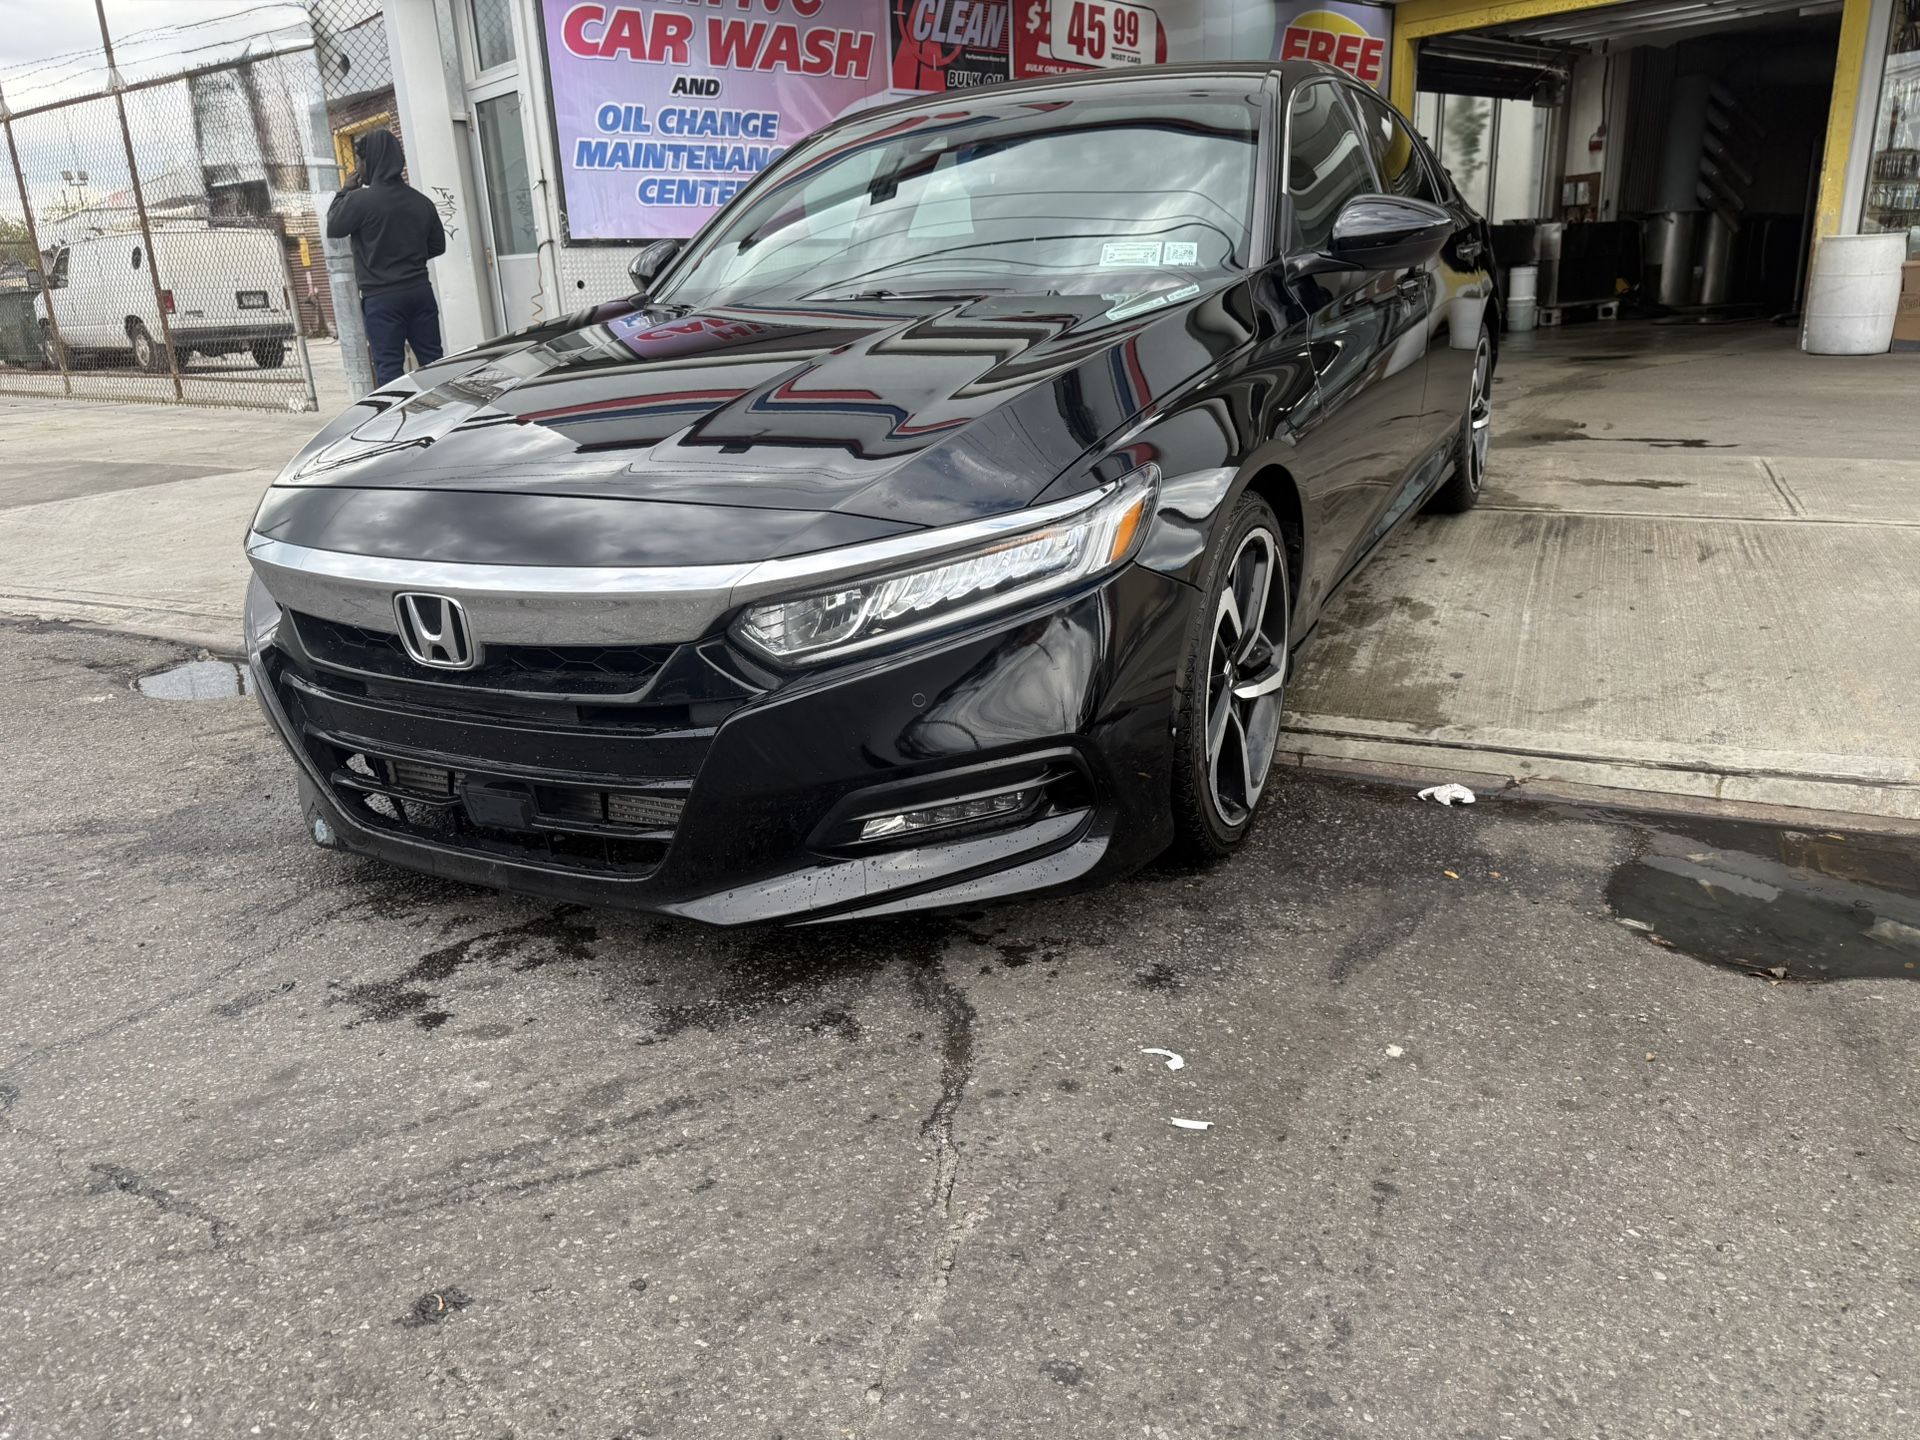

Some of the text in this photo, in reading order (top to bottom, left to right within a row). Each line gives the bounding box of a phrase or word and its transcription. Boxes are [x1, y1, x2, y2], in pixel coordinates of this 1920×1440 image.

[562, 3, 876, 79] CAR WASH
[913, 0, 1007, 48] CLEAN
[1067, 1, 1106, 59] 45
[1113, 8, 1139, 47] 99
[1111, 52, 1142, 64] MOST CARS
[1281, 27, 1384, 81] FREE
[672, 77, 721, 96] AND
[947, 70, 982, 87] BULK
[597, 104, 778, 138] OIL CHANGE
